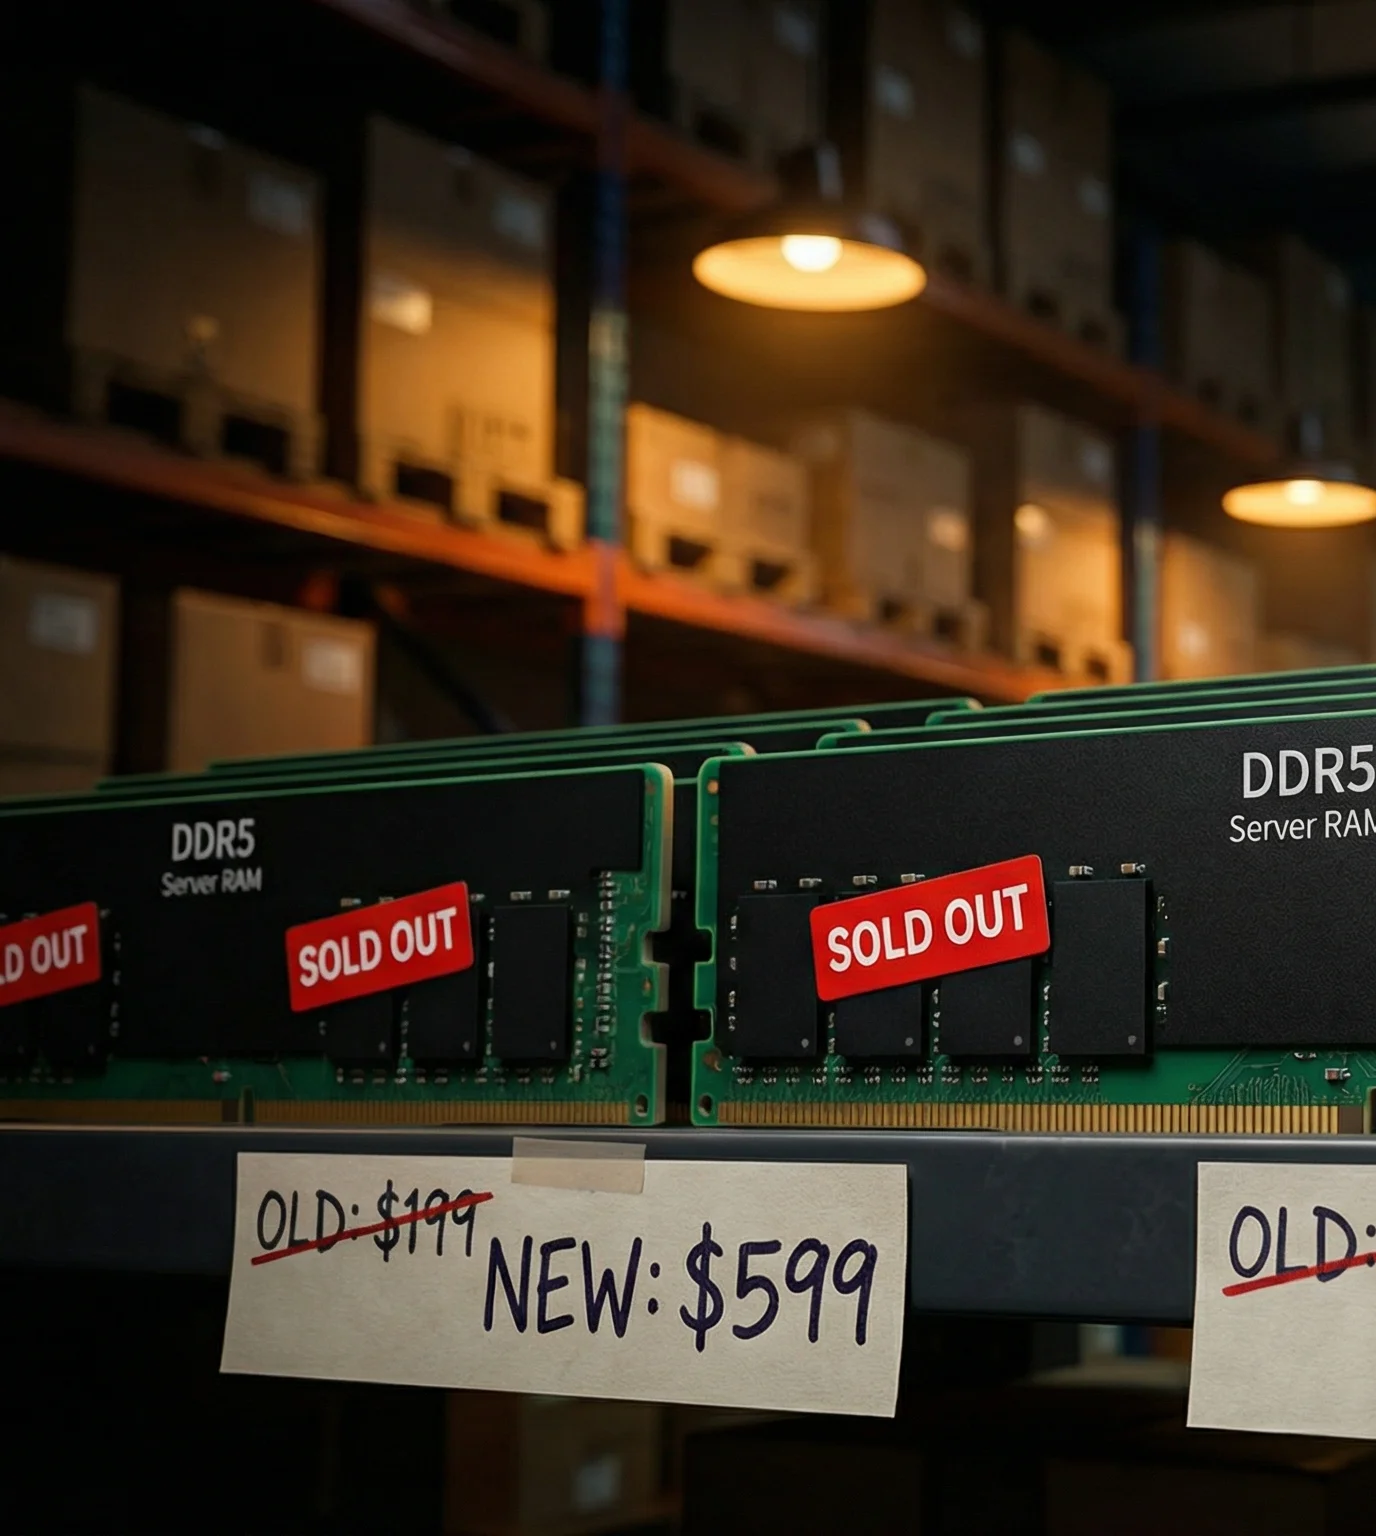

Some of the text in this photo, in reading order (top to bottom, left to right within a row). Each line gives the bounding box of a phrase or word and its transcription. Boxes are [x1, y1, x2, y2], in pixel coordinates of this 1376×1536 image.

[1242, 744, 1376, 799] DDR5
[171, 817, 256, 862] DDR5
[1229, 812, 1318, 844] Server
[160, 865, 263, 897] Server RAM
[30, 923, 89, 975] OUT
[297, 906, 459, 988] SOLD OUT
[827, 883, 1029, 974] SOLD OUT
[256, 1178, 478, 1263] OLD: $199
[483, 1220, 879, 1354] NEW: $599
